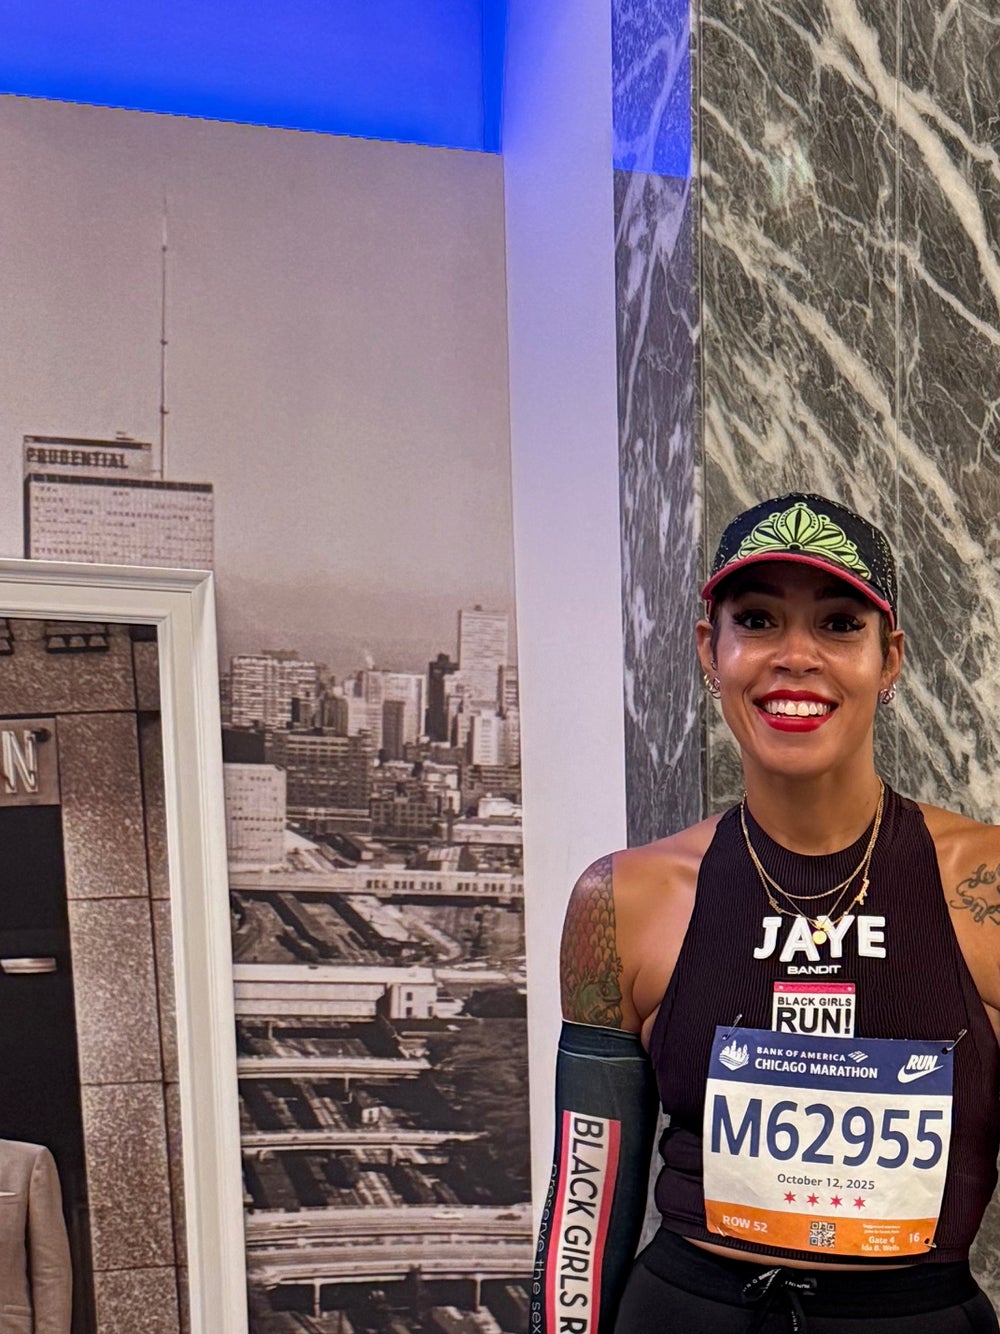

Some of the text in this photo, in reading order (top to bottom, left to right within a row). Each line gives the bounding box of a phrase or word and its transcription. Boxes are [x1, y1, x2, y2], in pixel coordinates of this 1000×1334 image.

[26, 447, 129, 469] PRUDENTIAL
[753, 914, 887, 963] JAYE
[786, 965, 842, 975] BANDIT
[777, 996, 852, 1007] BLACK GIRLS
[776, 1007, 852, 1035] RUN!
[756, 1046, 846, 1062] BANK OF AMERICA
[906, 1054, 939, 1071] RUN
[754, 1058, 878, 1079] CHICAGO MARATHON
[710, 1094, 944, 1170] M62955
[566, 1116, 604, 1220] BLACK
[777, 1173, 875, 1191] October 12, 2025
[722, 1215, 768, 1233] ROW 52
[868, 1236, 888, 1244] Gate
[909, 1232, 921, 1243] 16
[559, 1225, 592, 1308] GIRLS
[531, 1260, 545, 1296] the
